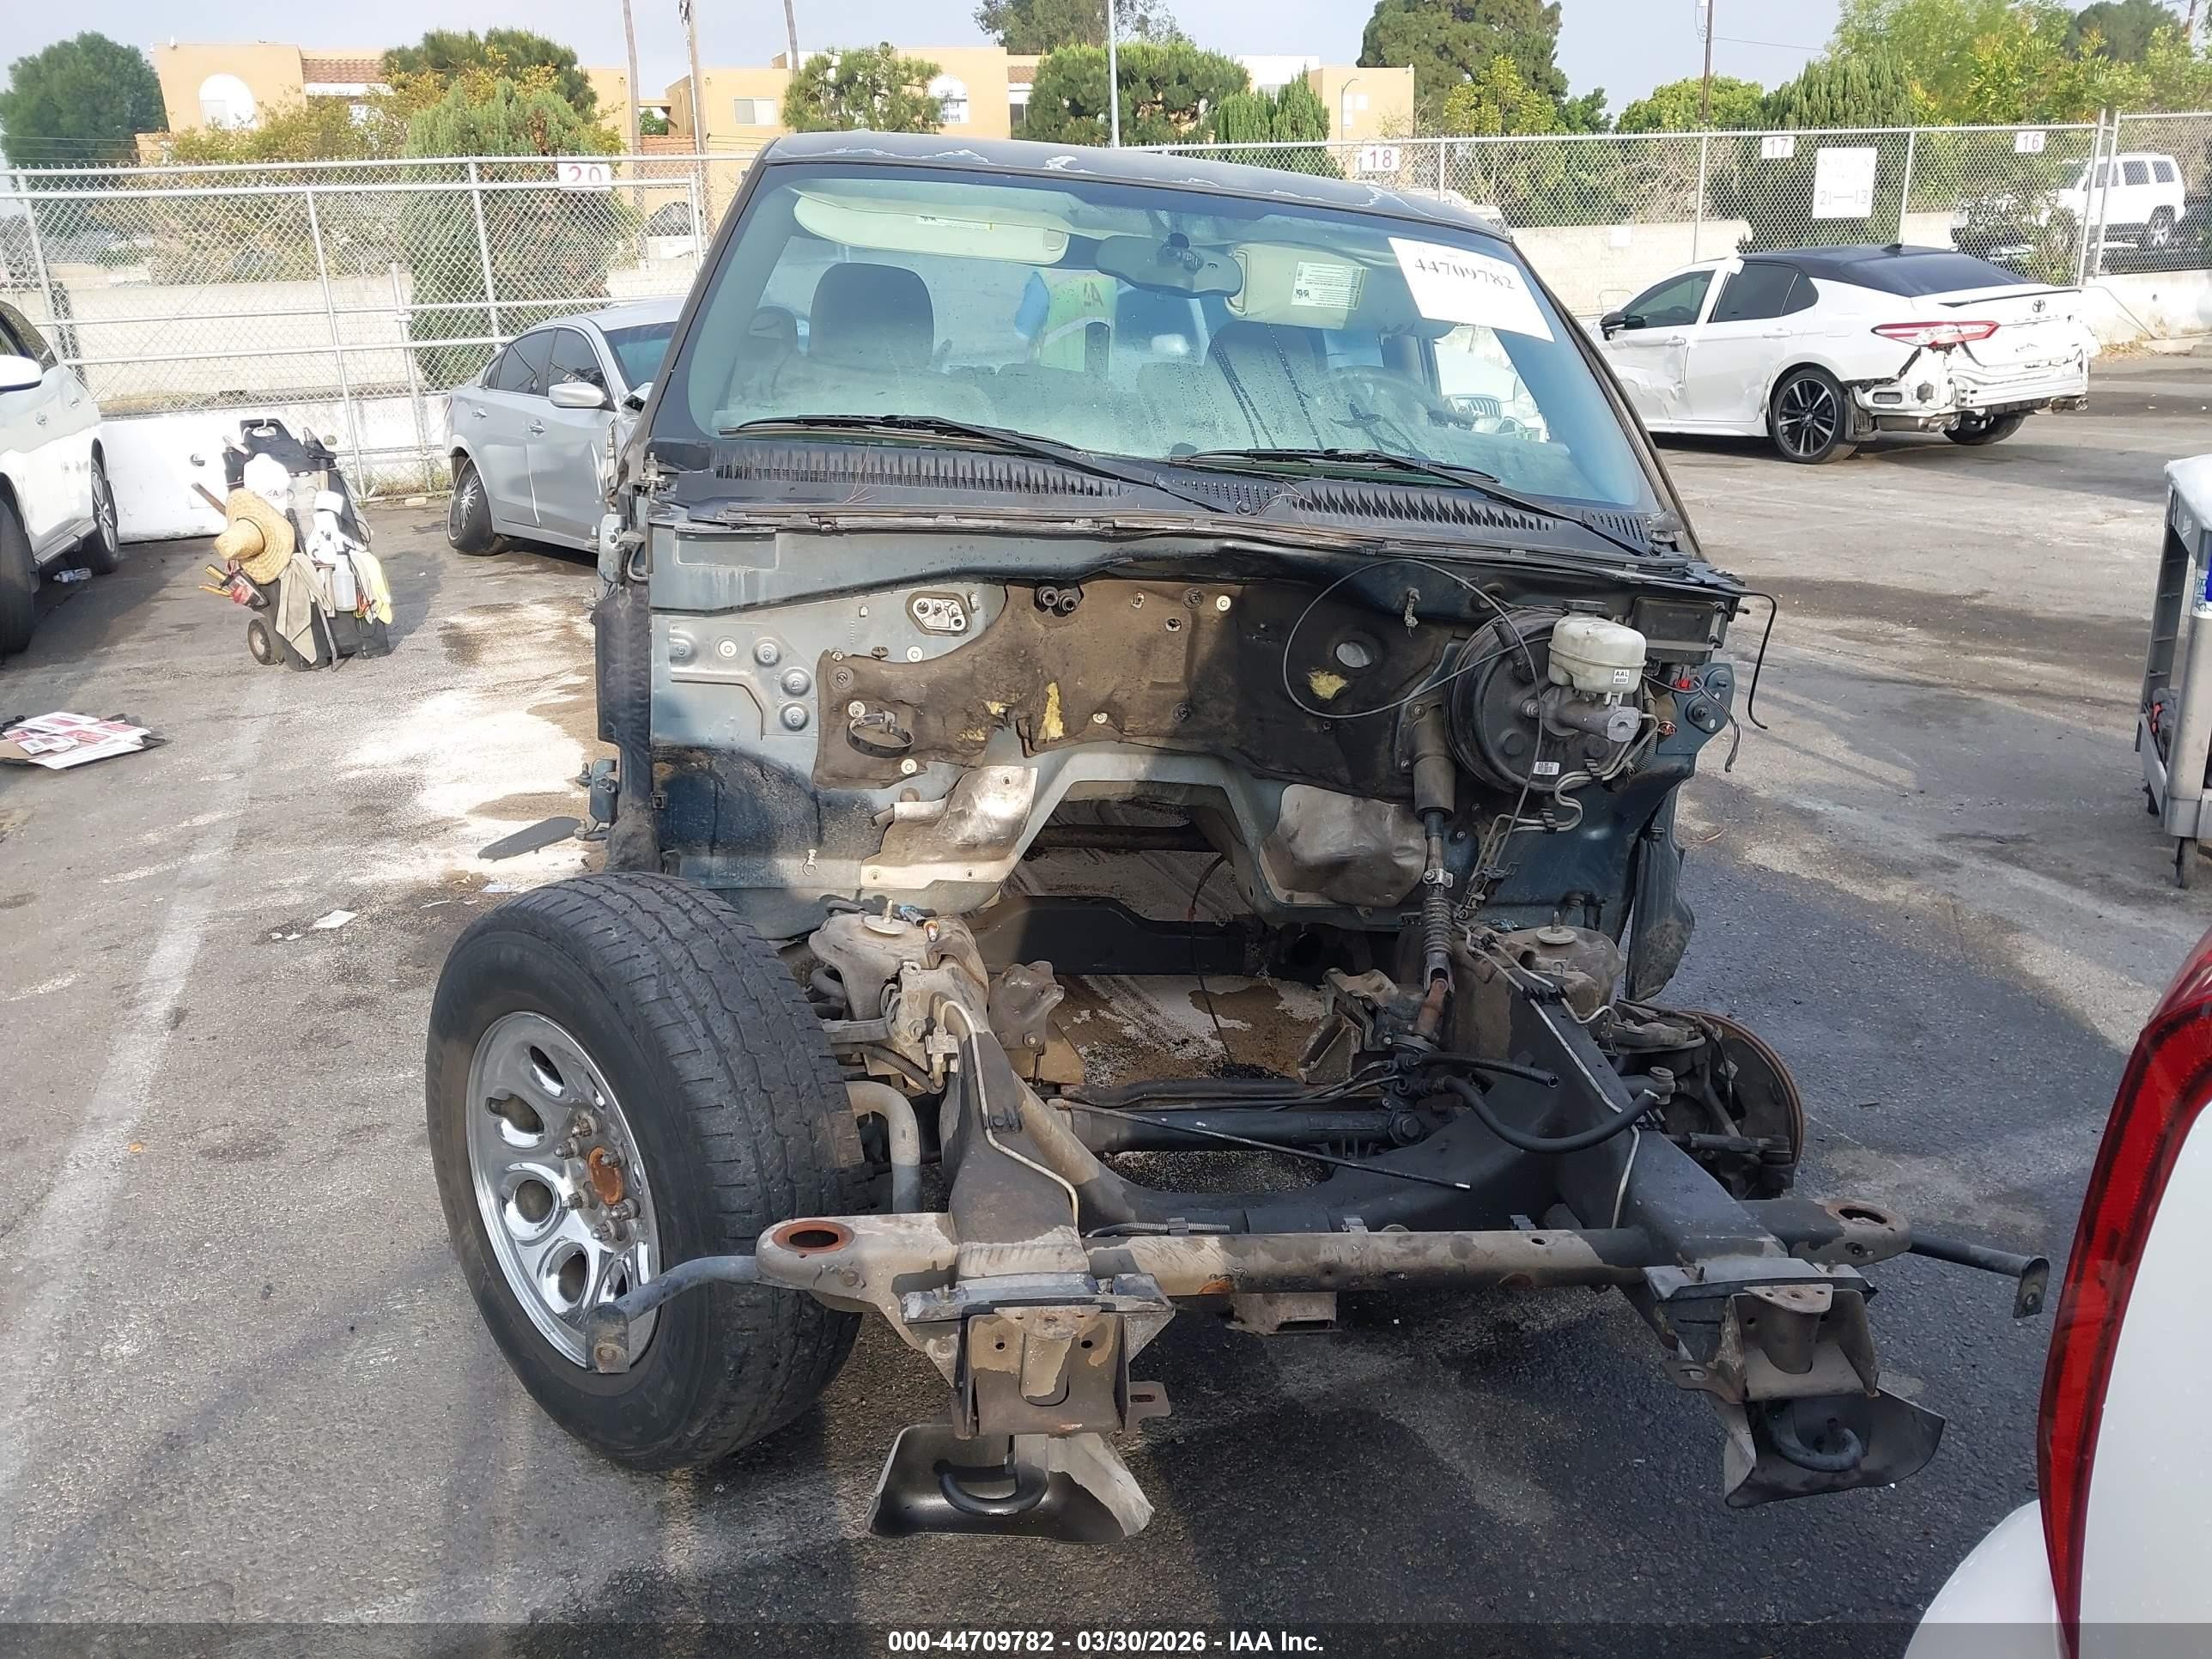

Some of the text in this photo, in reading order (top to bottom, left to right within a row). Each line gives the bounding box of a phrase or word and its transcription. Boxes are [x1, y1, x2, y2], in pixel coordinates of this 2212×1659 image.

[1769, 137, 1789, 156] 17
[2023, 133, 2040, 150] 16
[1369, 149, 1392, 168] 18
[568, 166, 603, 182] 20
